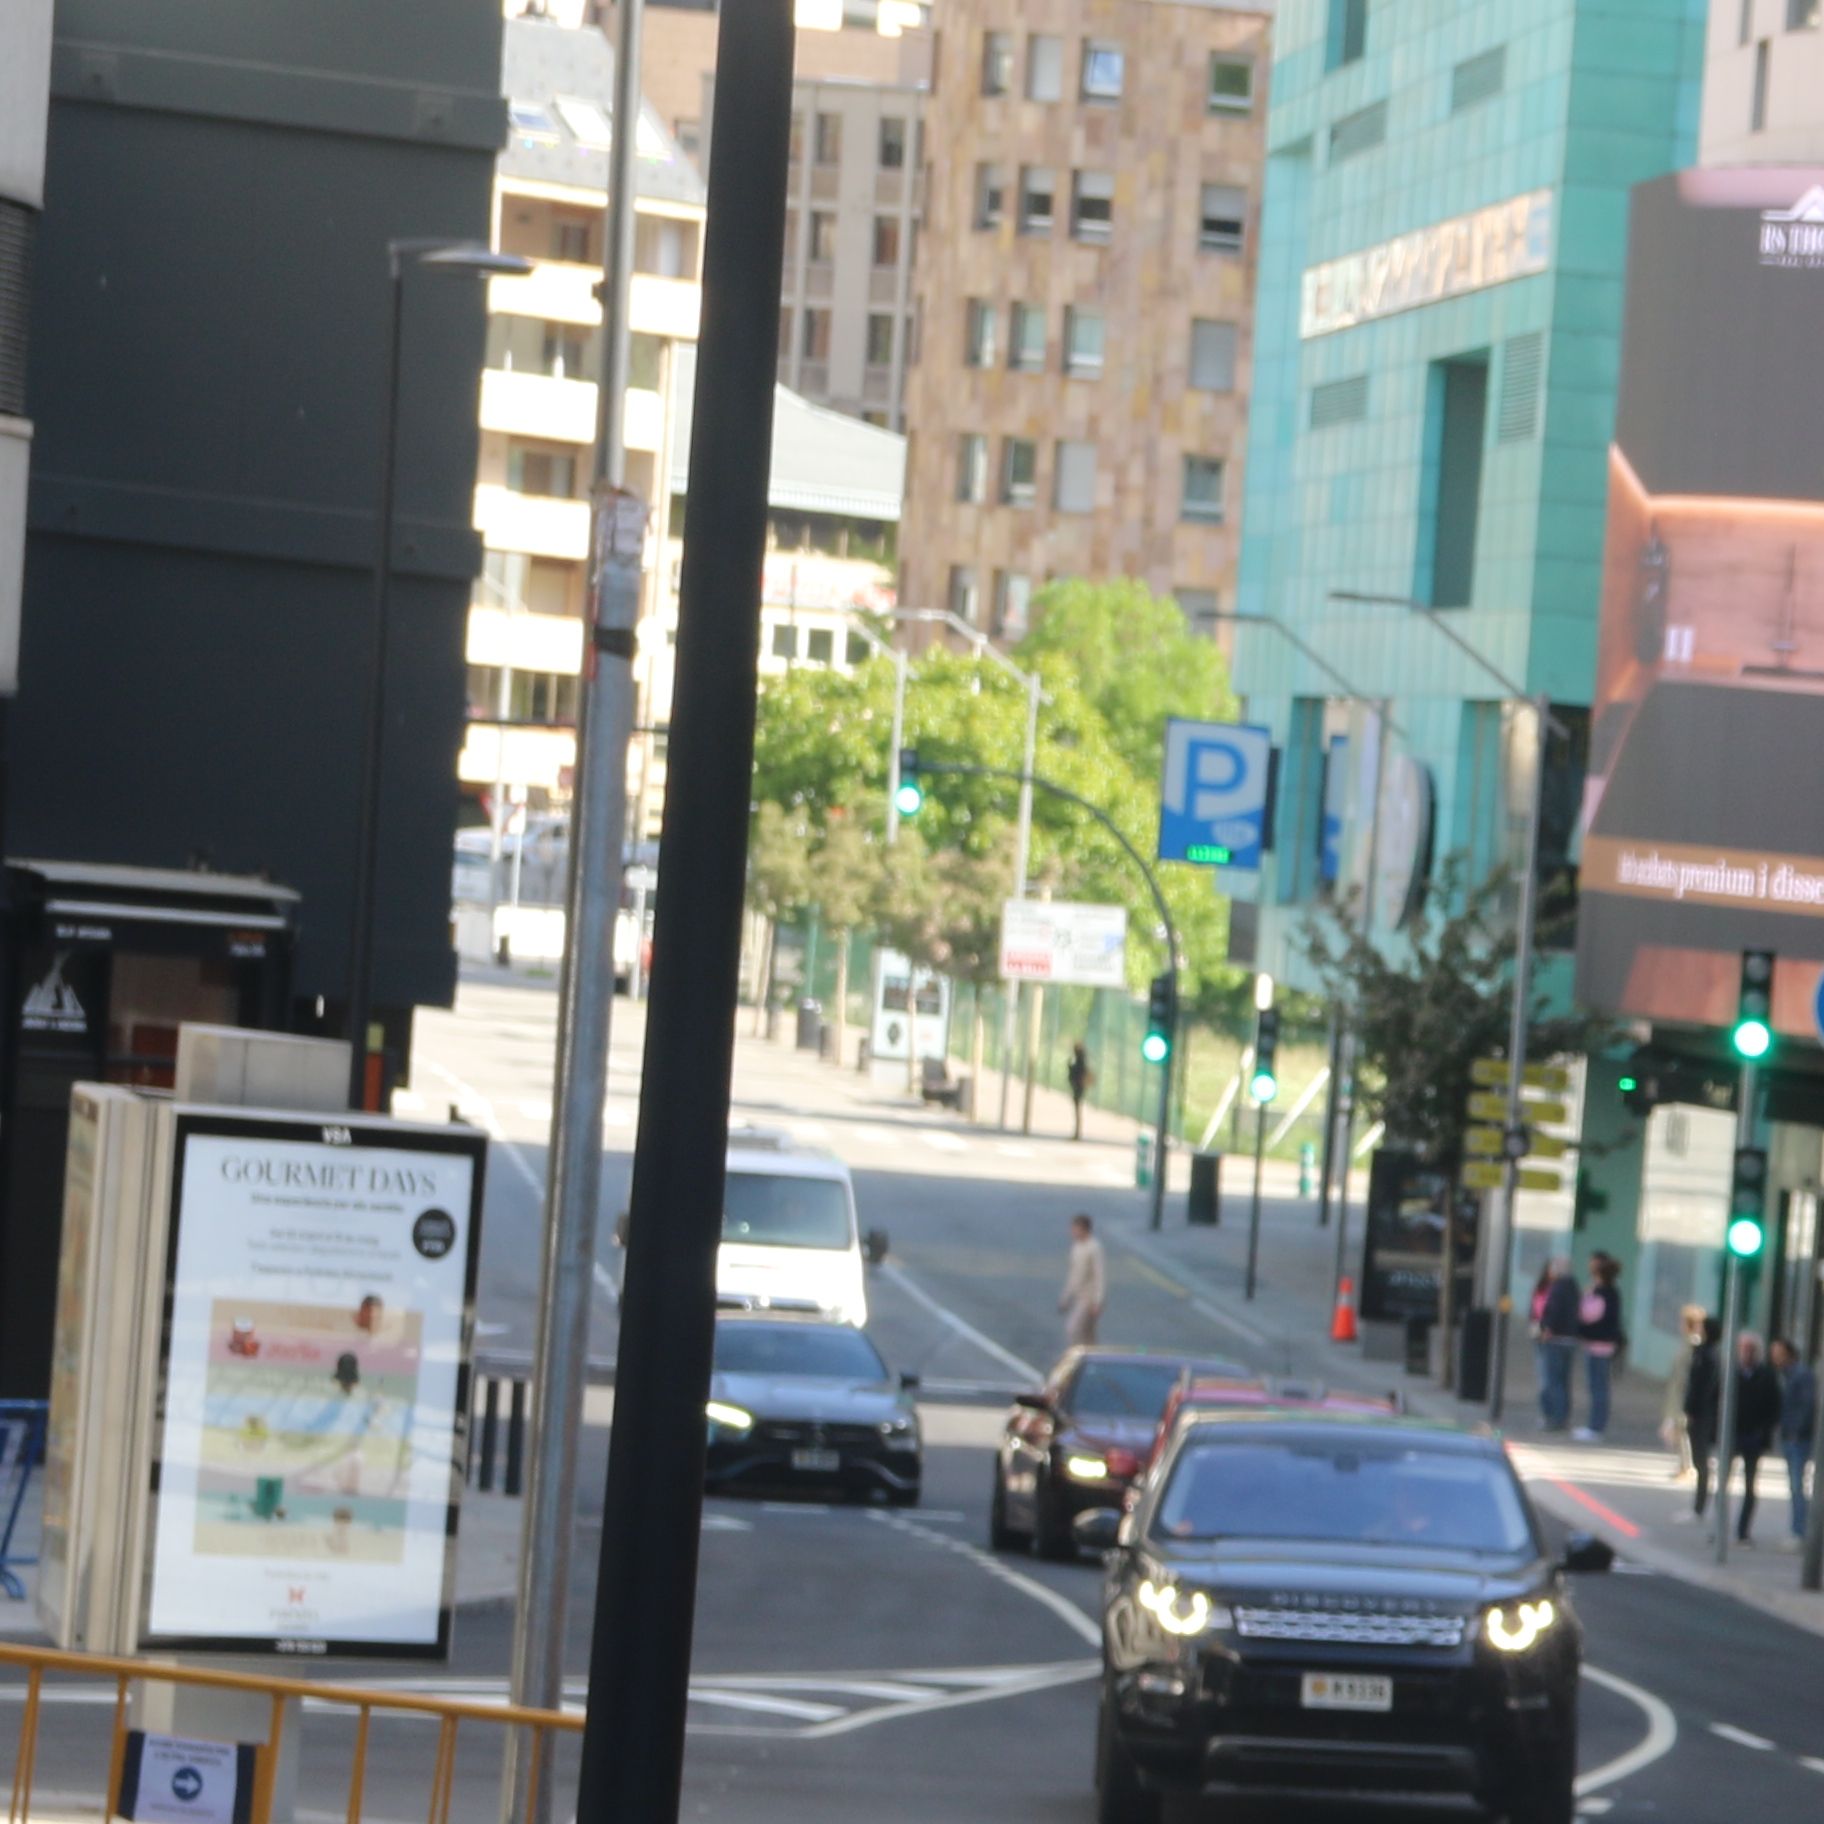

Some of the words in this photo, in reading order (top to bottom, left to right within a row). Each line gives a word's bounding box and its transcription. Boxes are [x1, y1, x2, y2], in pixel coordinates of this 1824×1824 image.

[1182, 738, 1249, 822] P
[221, 1156, 364, 1191] GOURMET
[369, 1167, 437, 1196] DAYS
